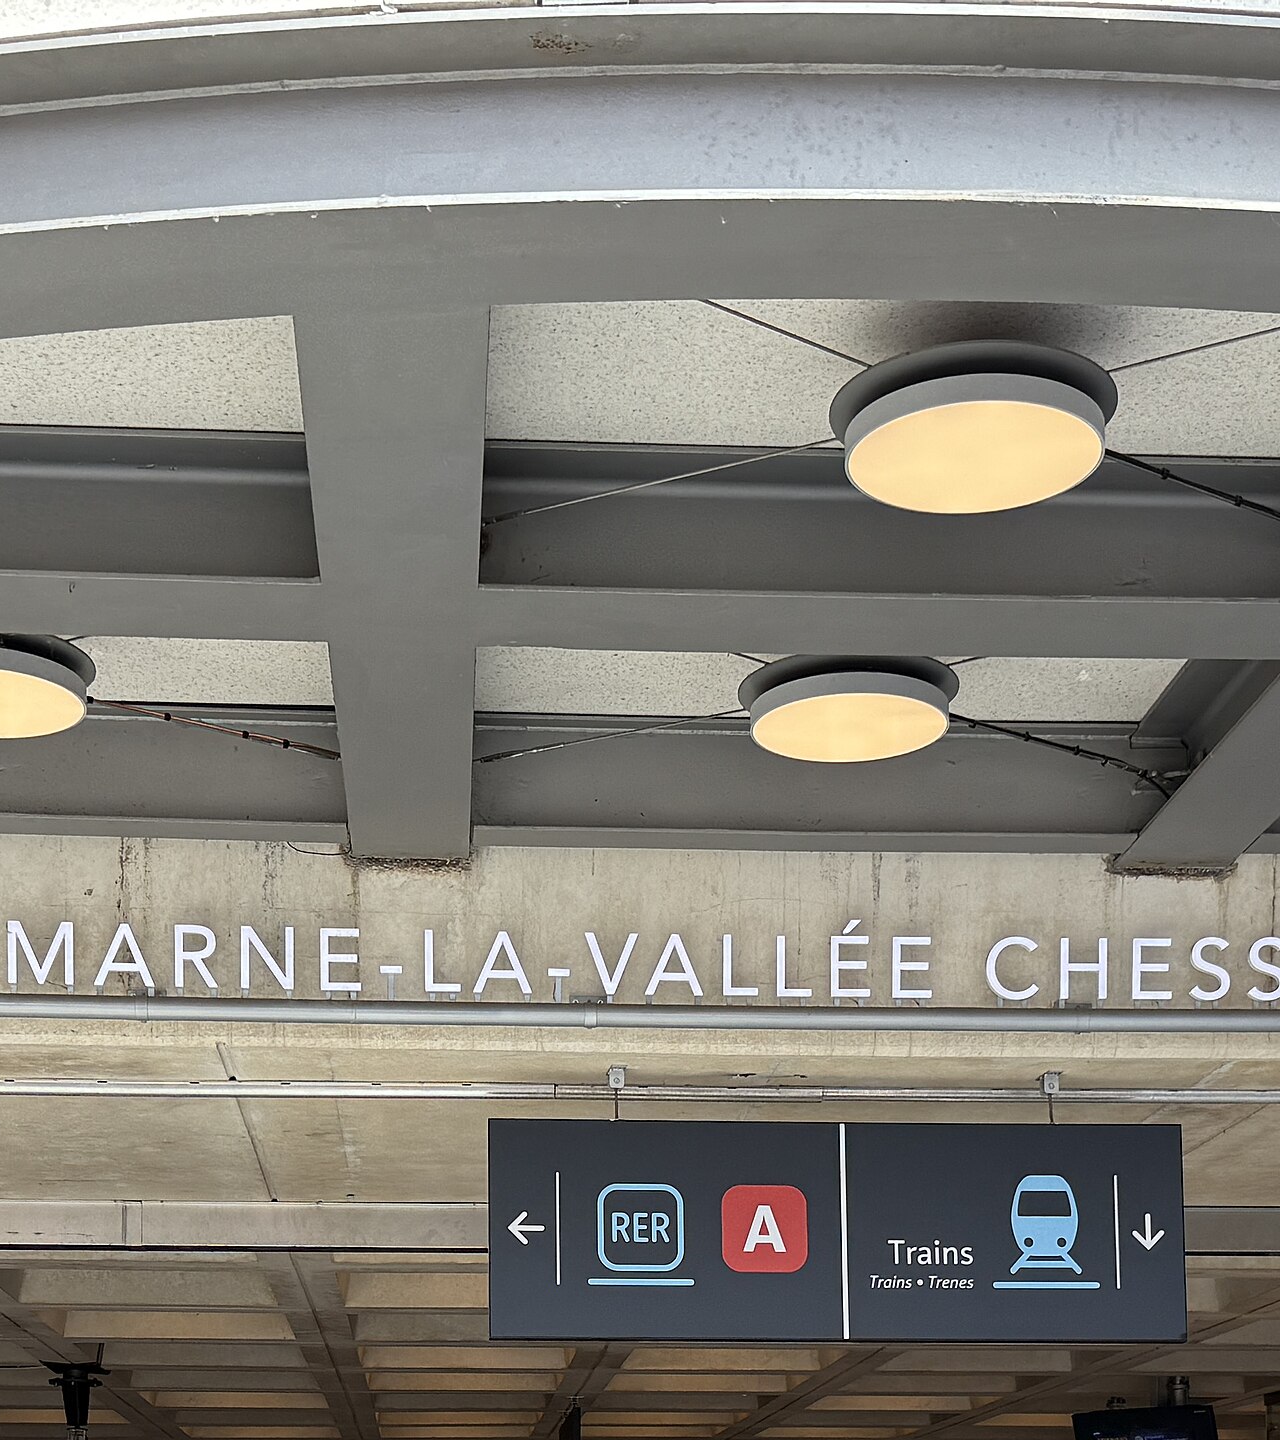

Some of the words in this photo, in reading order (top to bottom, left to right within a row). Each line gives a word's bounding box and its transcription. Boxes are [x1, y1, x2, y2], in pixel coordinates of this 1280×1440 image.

[6, 919, 933, 1001] MARNE-LA-VALLÉE
[611, 1212, 671, 1244] RER
[743, 1204, 788, 1253] A
[887, 1239, 974, 1267] Trains
[869, 1274, 913, 1290] Trains
[928, 1274, 975, 1290] Trenes
